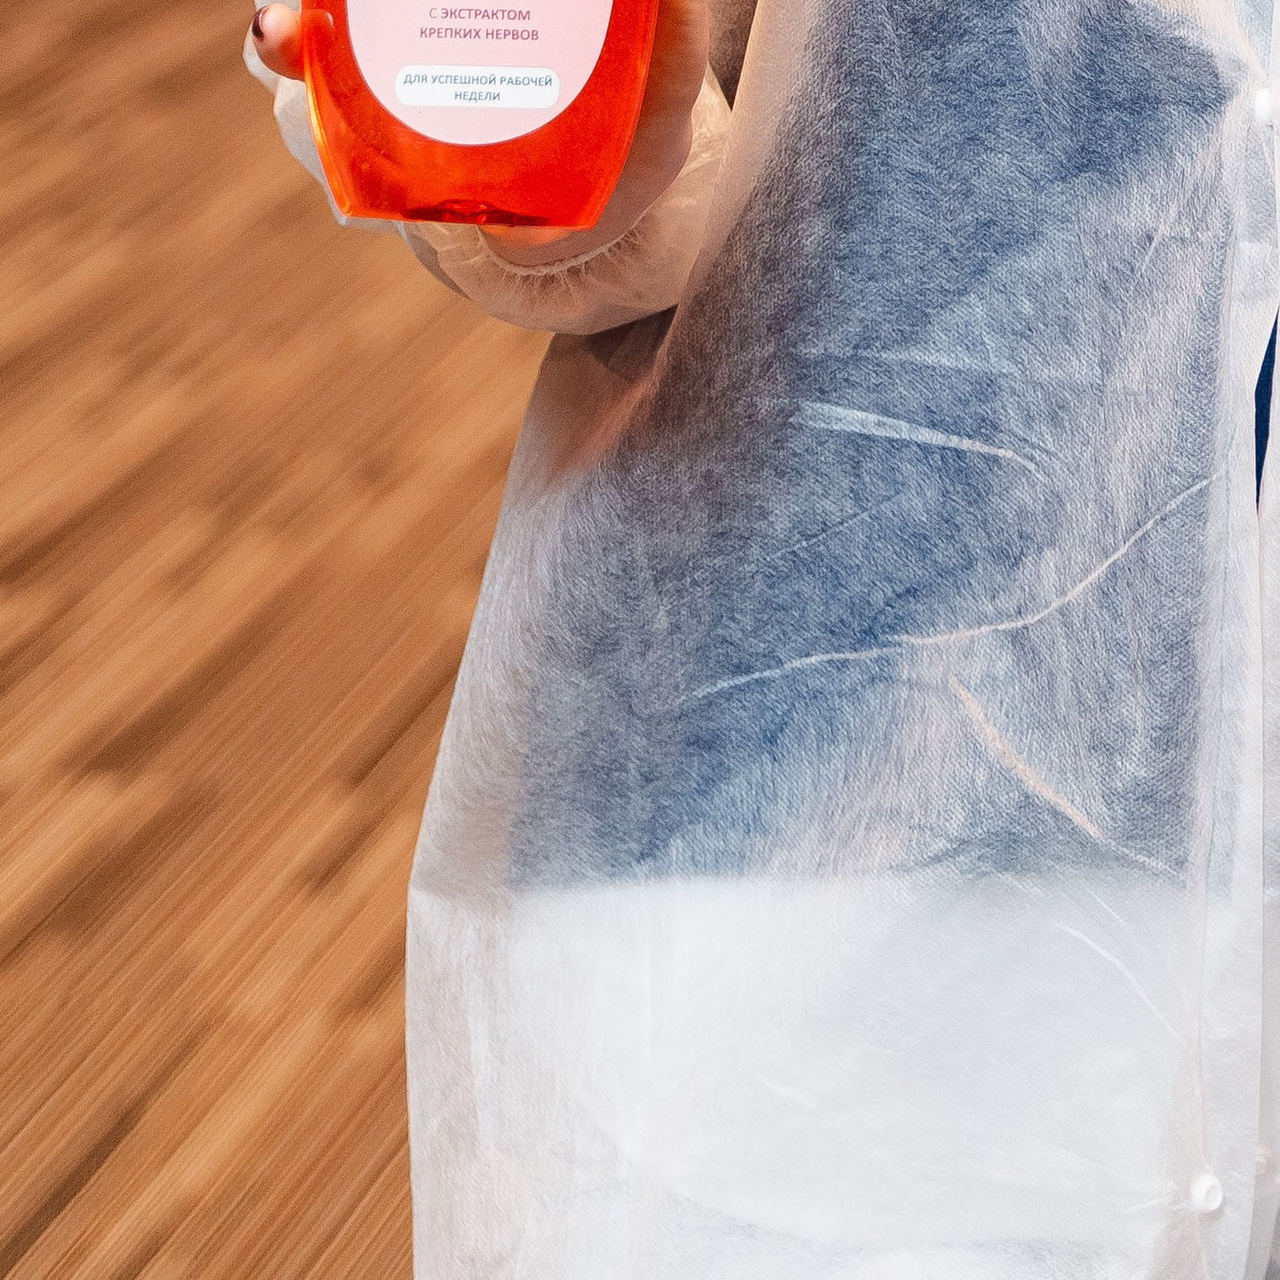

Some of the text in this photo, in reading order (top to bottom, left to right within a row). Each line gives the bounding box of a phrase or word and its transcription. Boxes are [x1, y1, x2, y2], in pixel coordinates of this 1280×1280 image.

[428, 7, 531, 21] С ЭКСТРАКТОМ
[419, 27, 539, 41] КРЕПКИХ НЕРВОВ
[403, 73, 553, 87] ДЛЯ УСПЕШНОЙ РАБОЧЕЙ
[454, 91, 501, 102] НЕДЕЛИ
